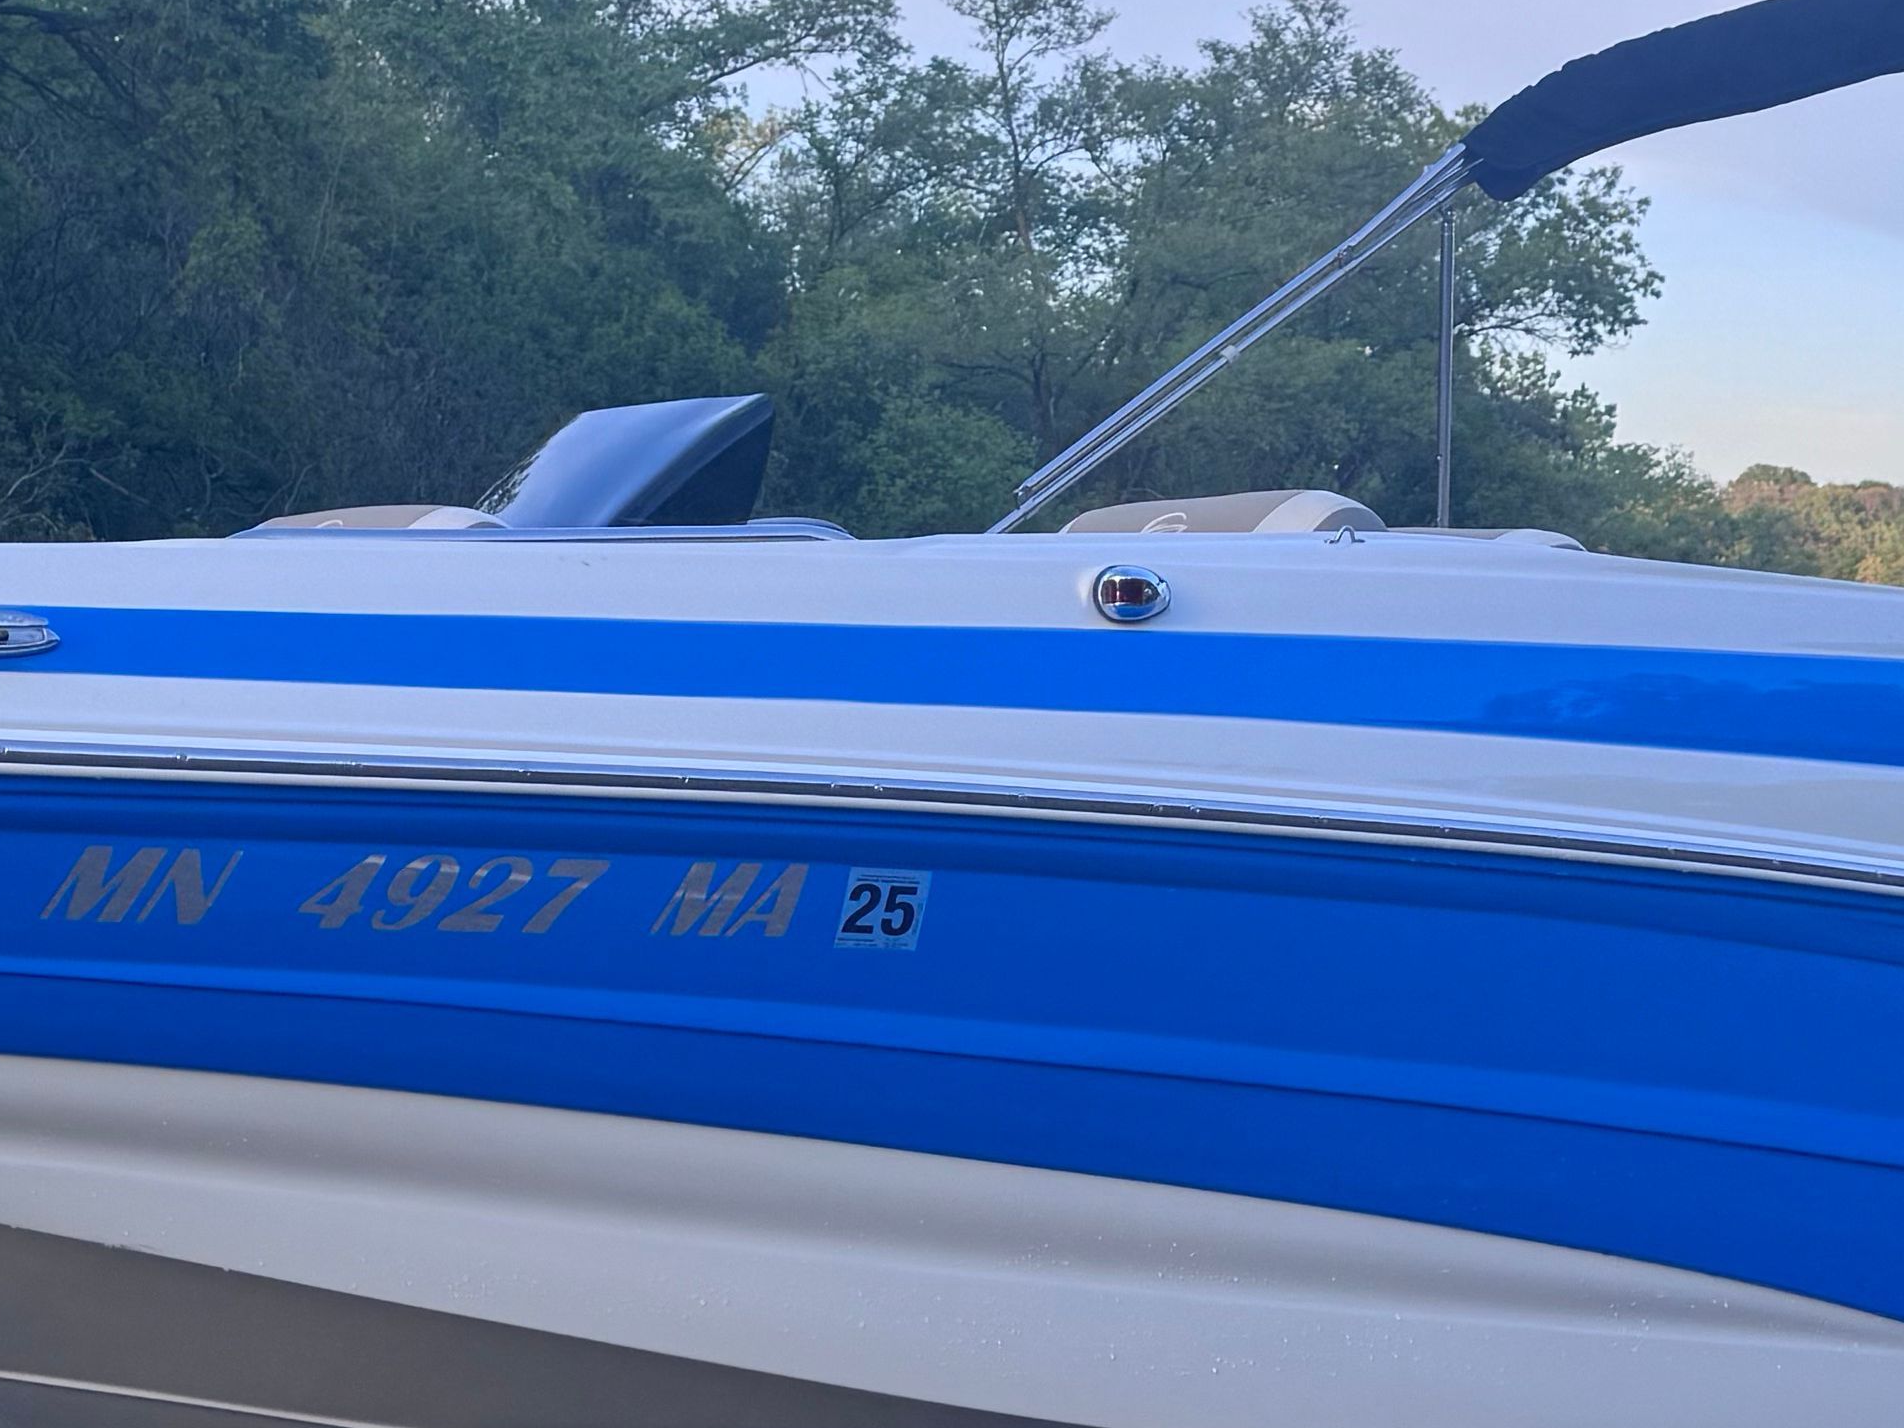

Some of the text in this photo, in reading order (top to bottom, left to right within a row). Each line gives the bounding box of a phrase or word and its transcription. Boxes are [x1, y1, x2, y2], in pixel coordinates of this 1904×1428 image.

[40, 845, 810, 938] MN 4927 MA
[841, 883, 919, 936] 25
